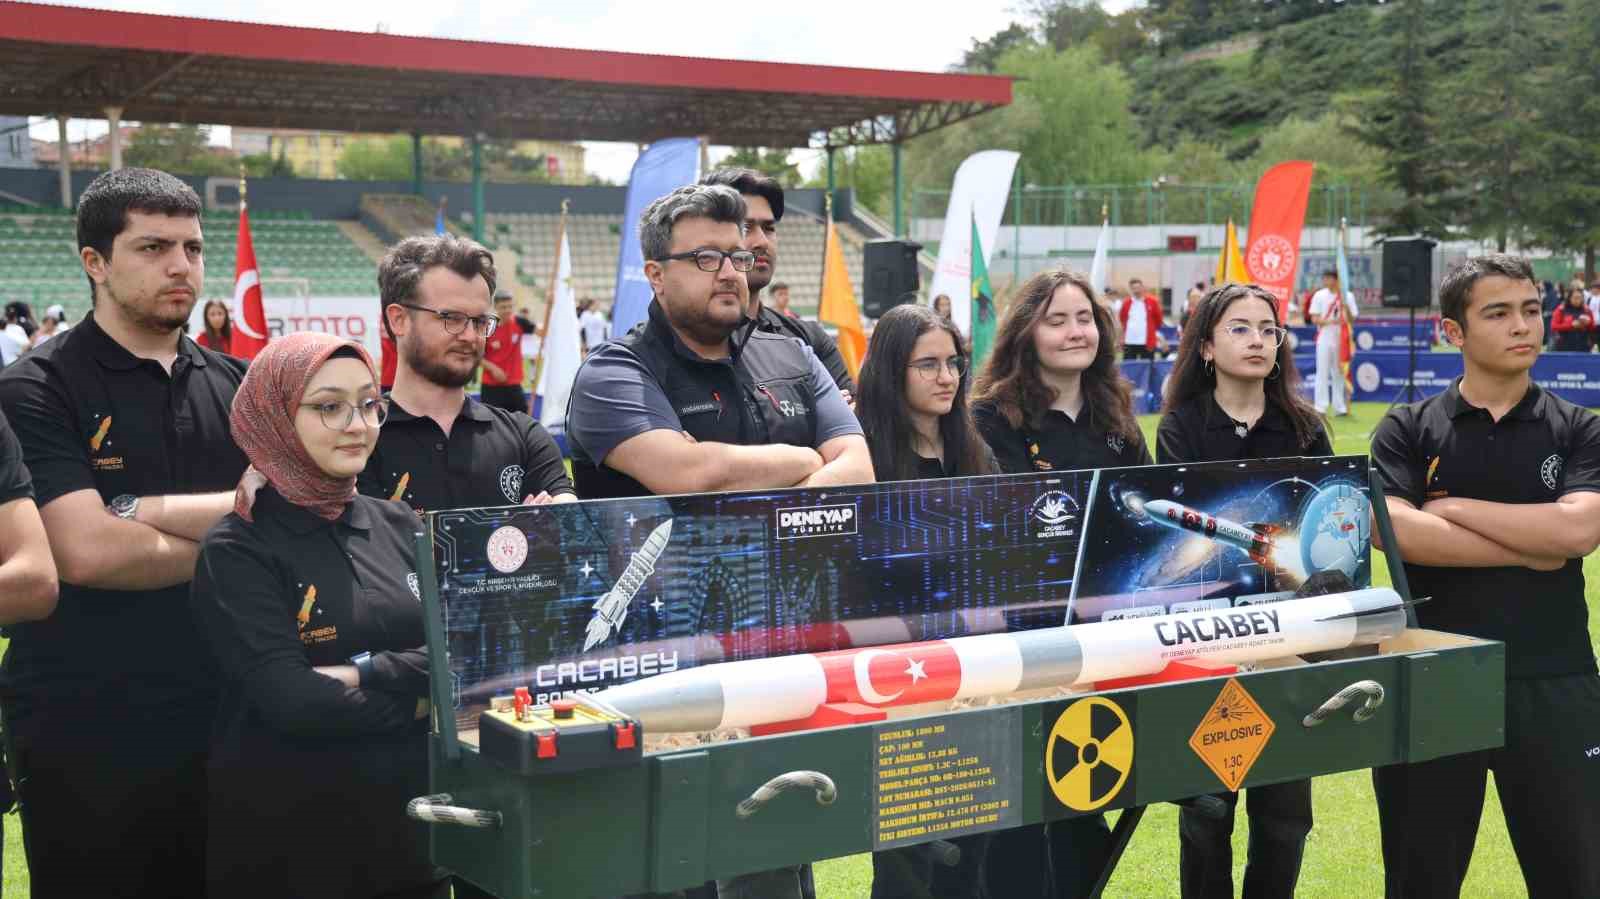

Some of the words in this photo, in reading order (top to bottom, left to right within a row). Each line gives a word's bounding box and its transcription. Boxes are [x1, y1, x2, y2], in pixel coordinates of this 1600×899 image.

[780, 508, 853, 528] DENEYAP
[792, 524, 843, 534] TÜRKİYE
[1154, 608, 1280, 646] CACABEY
[536, 650, 678, 687] CACABEY
[1202, 724, 1263, 746] EXPLOSIVE
[1224, 754, 1242, 768] 1.3C
[1230, 771, 1236, 782] 1
